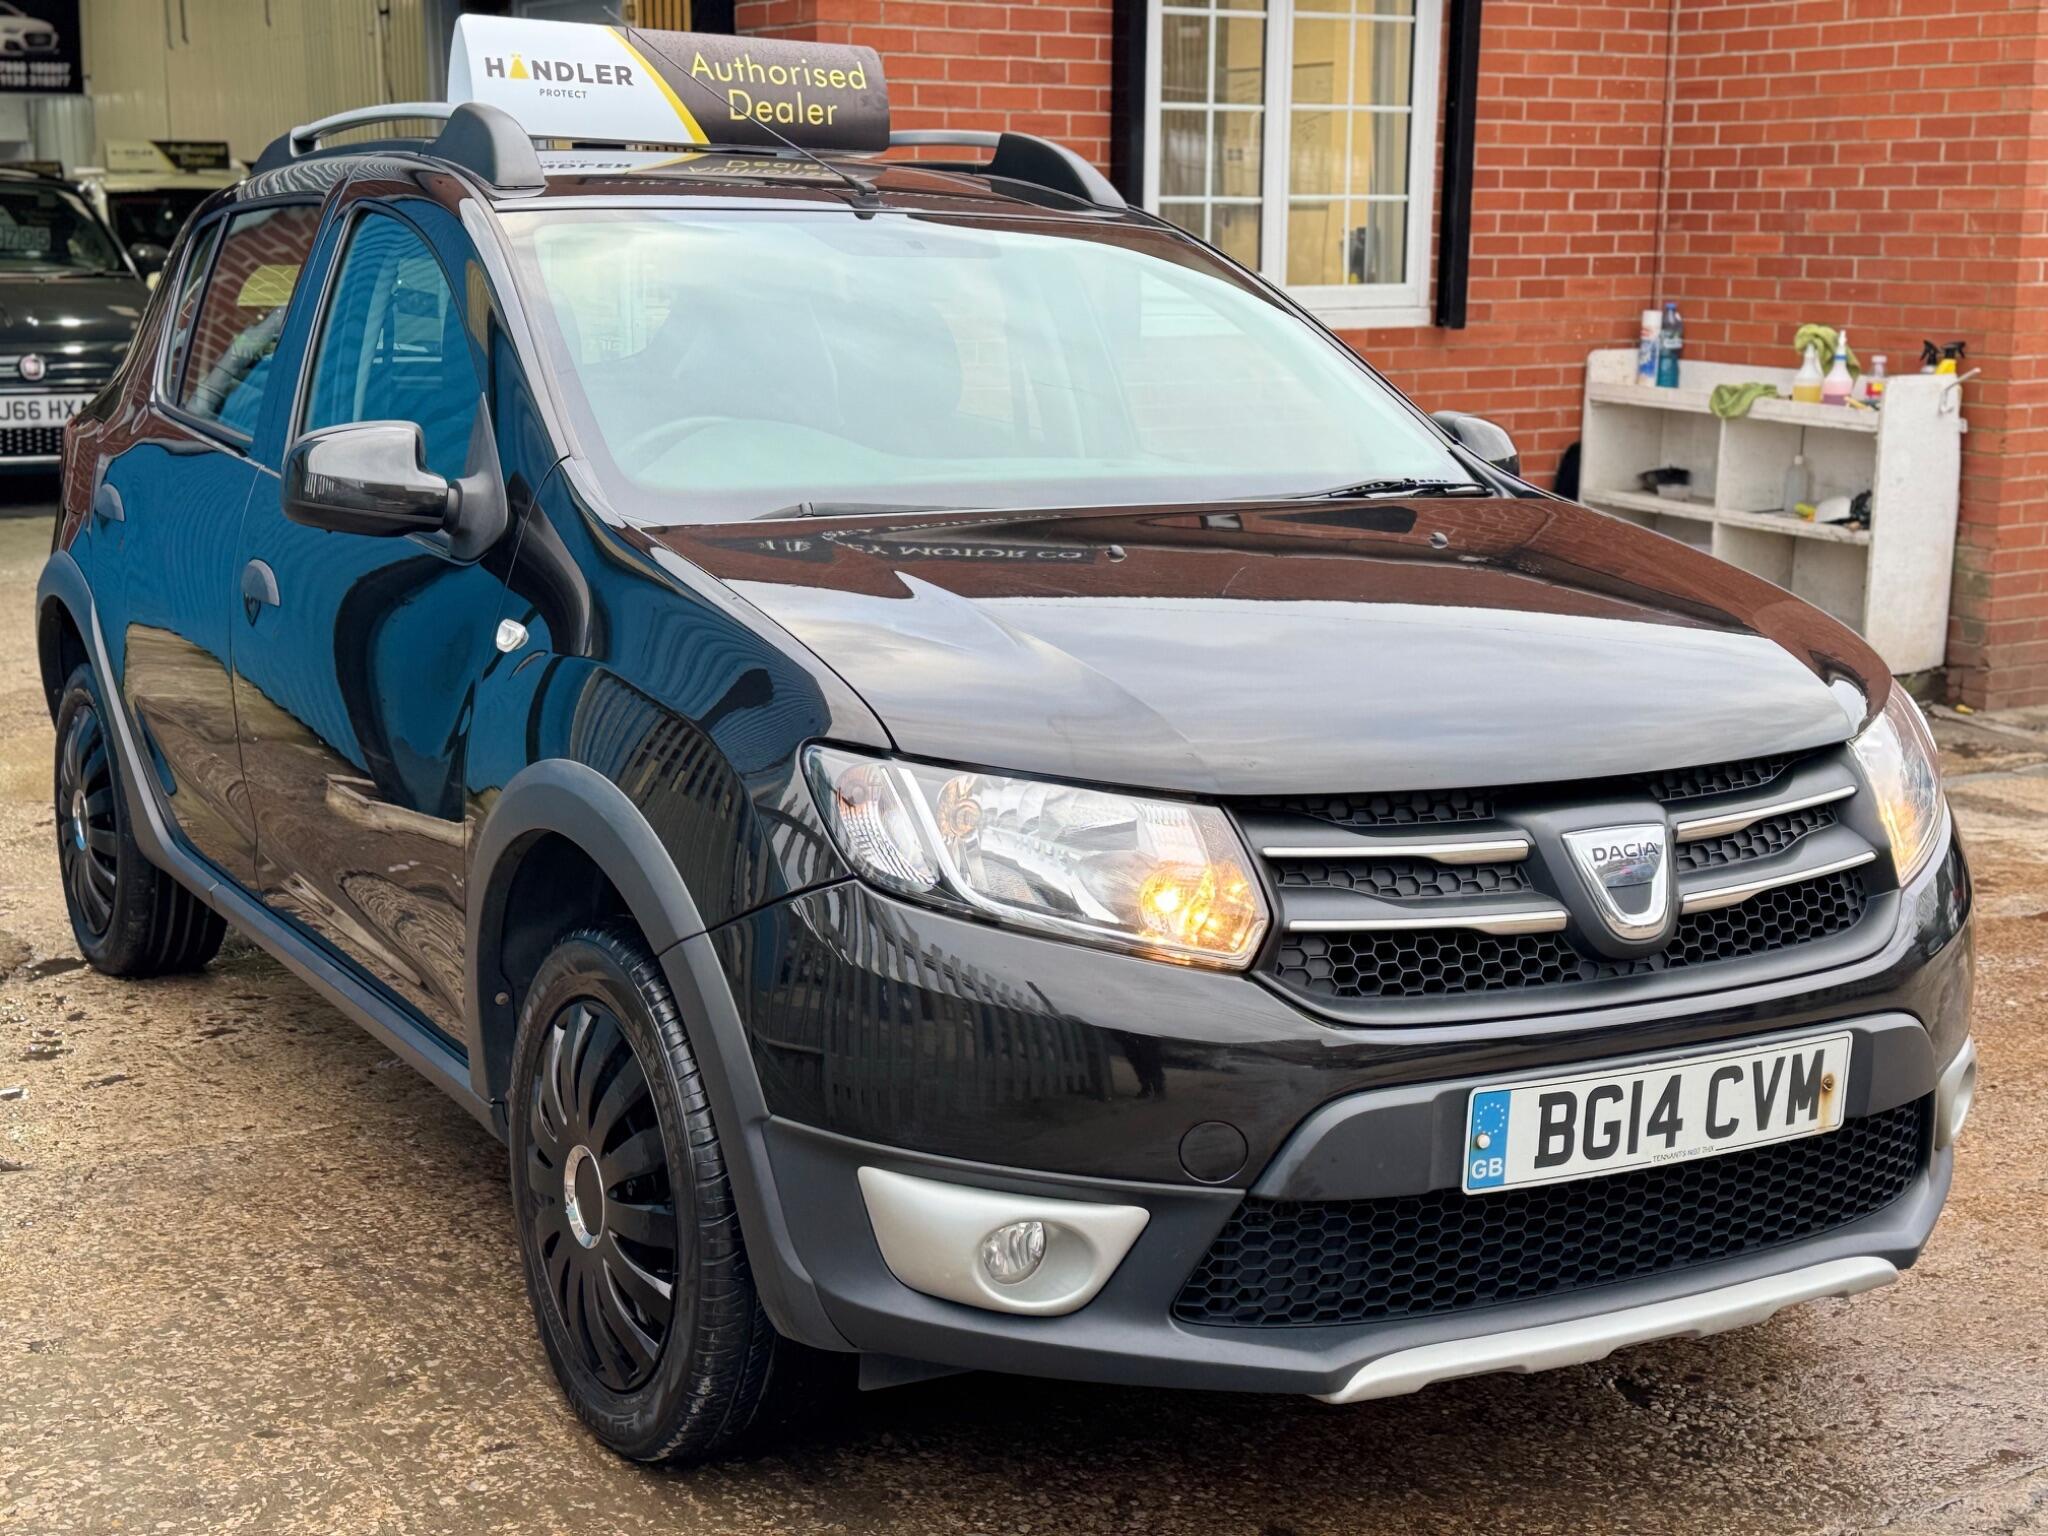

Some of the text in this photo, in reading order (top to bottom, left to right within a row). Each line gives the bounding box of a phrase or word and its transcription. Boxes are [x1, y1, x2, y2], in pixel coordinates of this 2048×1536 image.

[691, 51, 868, 91] Authorised
[539, 88, 588, 99] PROTECT
[728, 89, 838, 126] Dealer
[48, 400, 88, 420] HX
[1592, 841, 1659, 862] DACIA
[1534, 1049, 1825, 1169] BG14 CVM
[1471, 1157, 1503, 1180] GB
